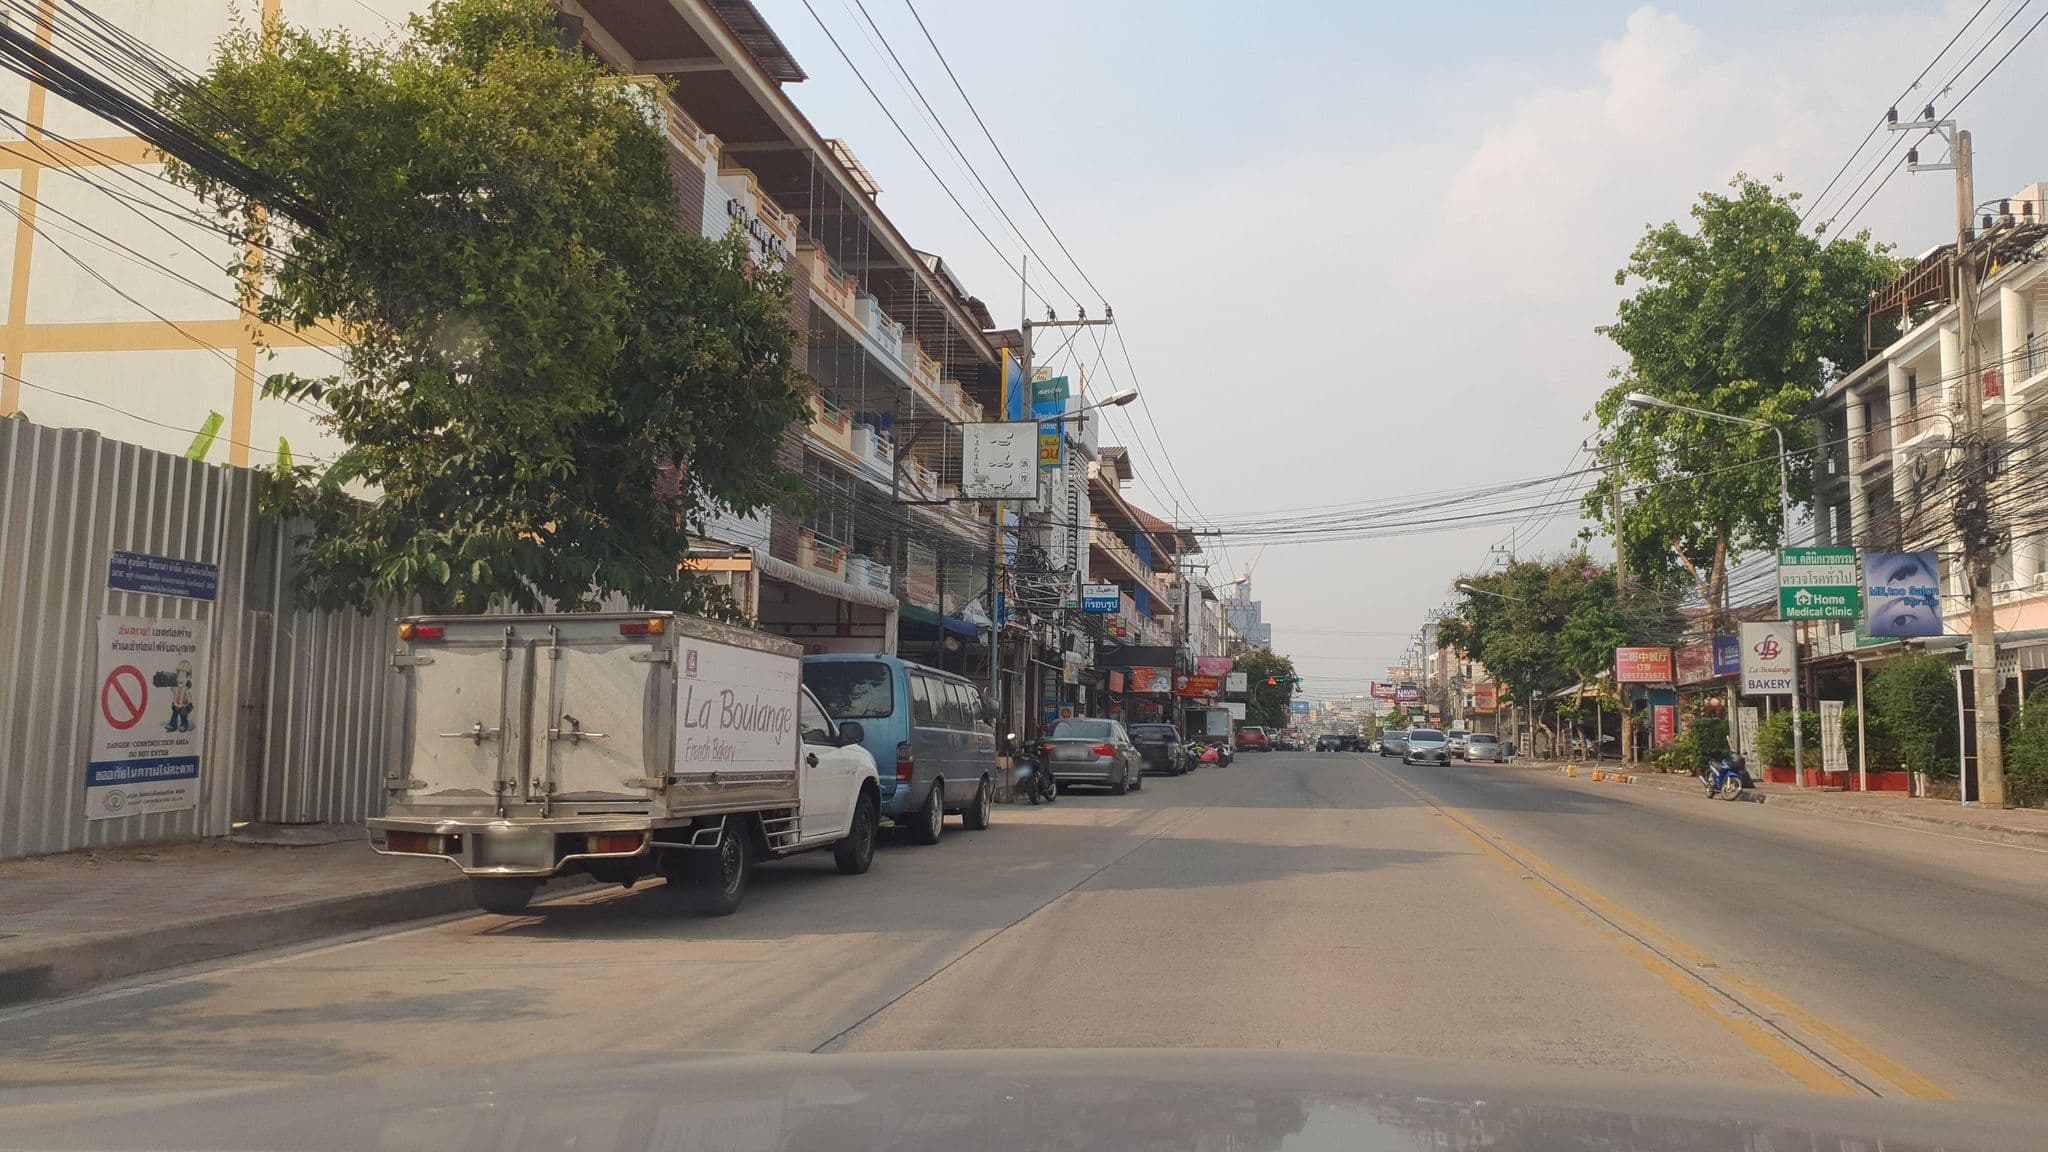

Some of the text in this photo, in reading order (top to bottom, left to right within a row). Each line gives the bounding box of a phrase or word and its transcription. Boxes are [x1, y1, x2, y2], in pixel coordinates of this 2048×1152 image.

[1783, 567, 1852, 584] ตรวจโรคทั่วไป
[1814, 594, 1845, 604] Home
[1786, 607, 1853, 617] Medical Clinic
[1748, 679, 1791, 689] BAKERY
[684, 685, 792, 746] La Boulange
[685, 737, 736, 767] French Bakery
